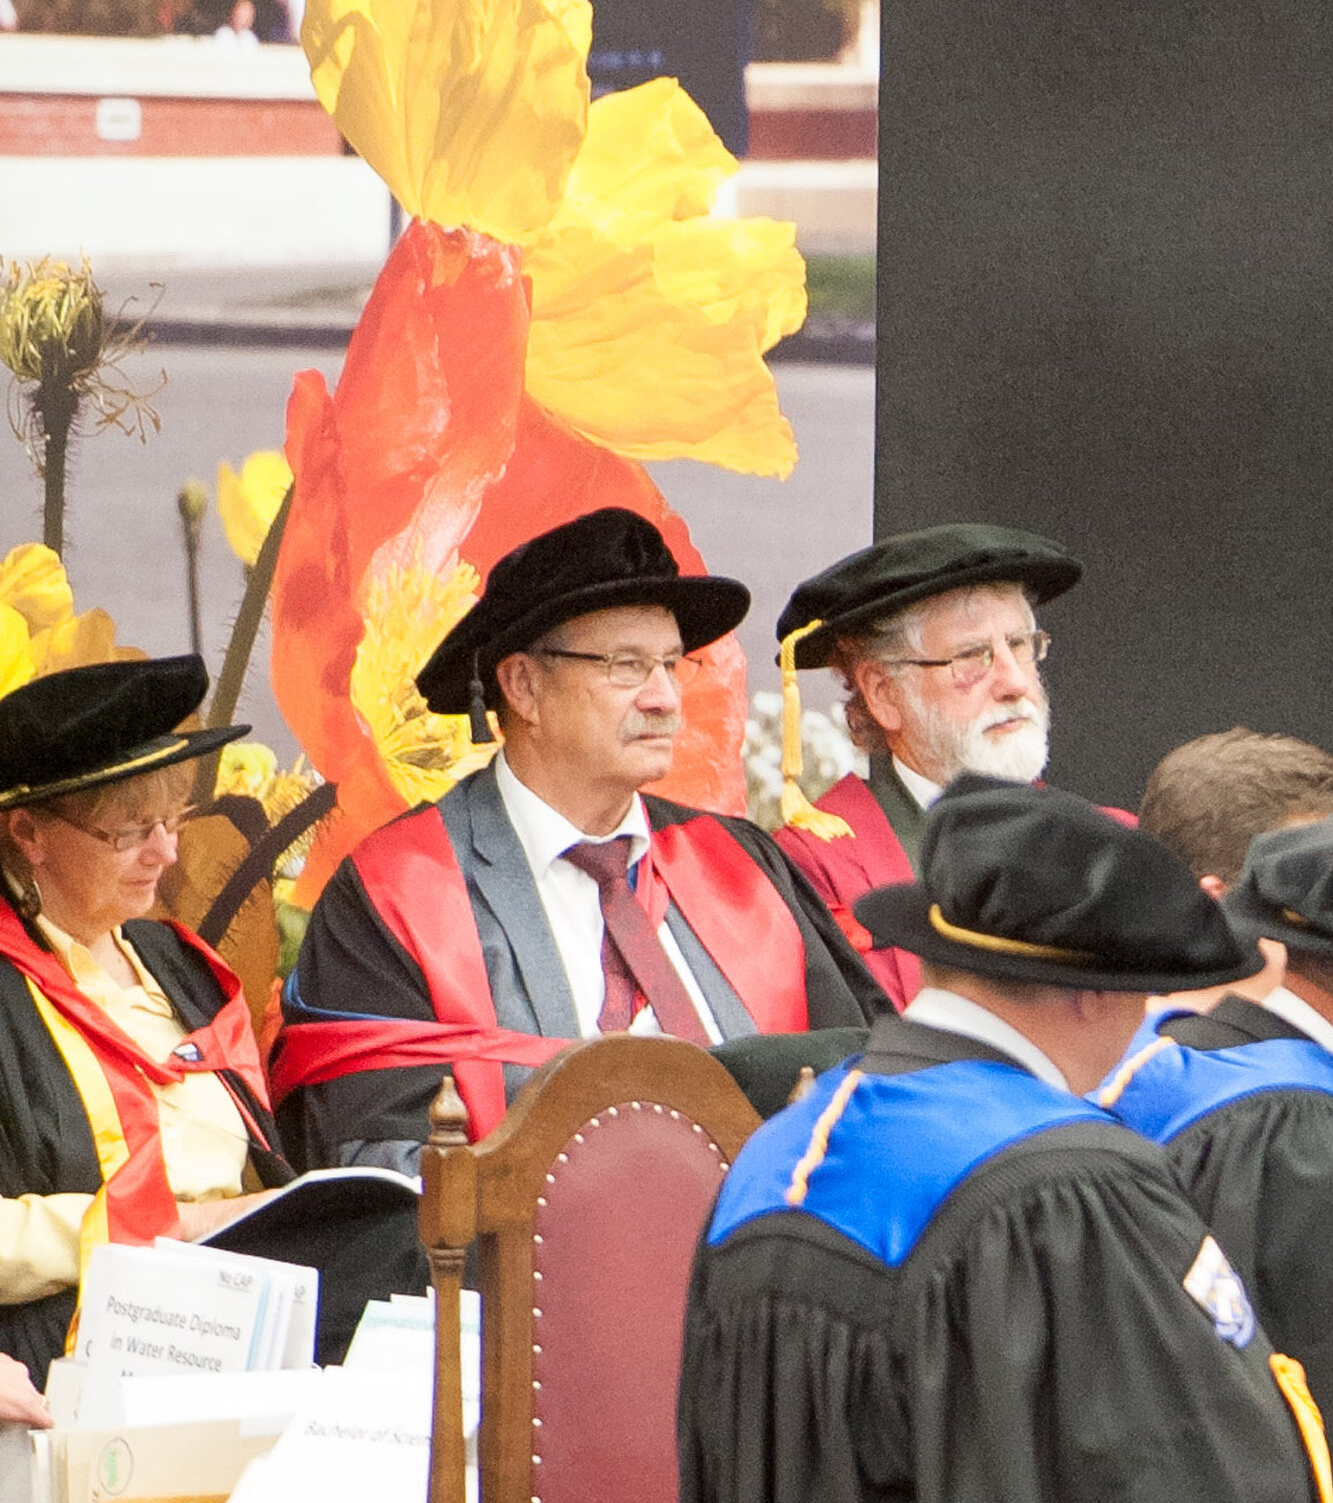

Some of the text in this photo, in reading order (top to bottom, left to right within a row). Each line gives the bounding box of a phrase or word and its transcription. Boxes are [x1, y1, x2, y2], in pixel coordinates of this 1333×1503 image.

[218, 1270, 253, 1289] No CAP
[105, 1294, 241, 1341] Postgraduate Diploma
[110, 1331, 122, 1350] in
[126, 1336, 164, 1358] Water
[167, 1344, 222, 1372] Resource
